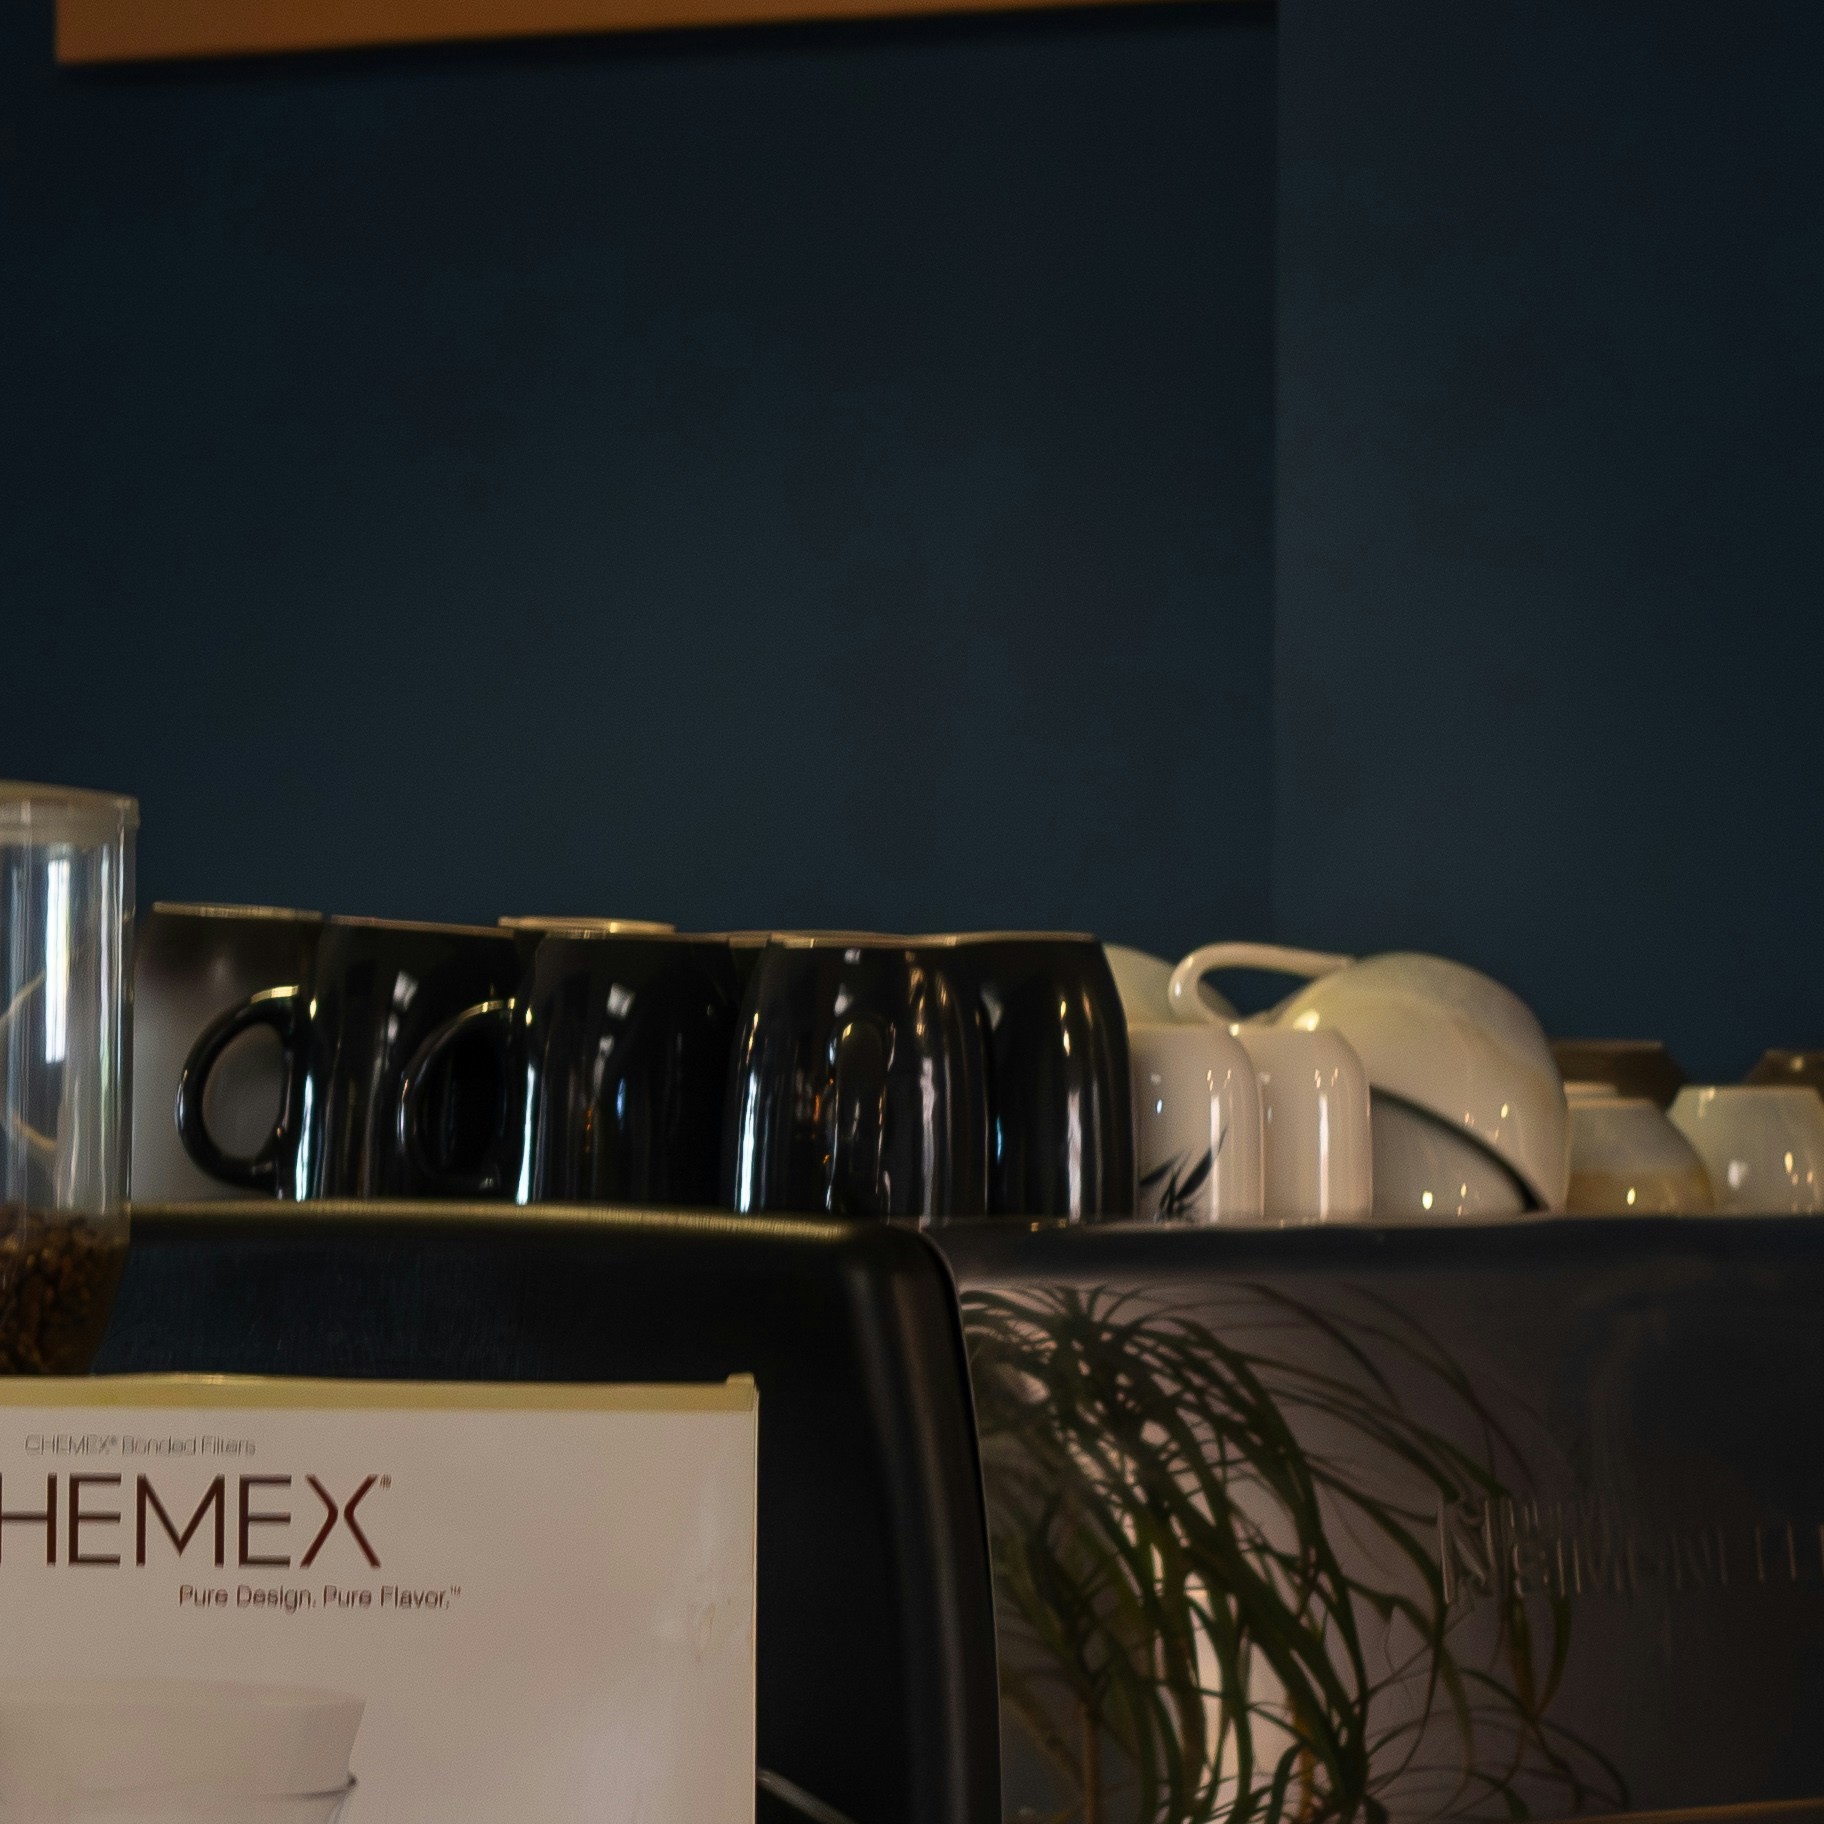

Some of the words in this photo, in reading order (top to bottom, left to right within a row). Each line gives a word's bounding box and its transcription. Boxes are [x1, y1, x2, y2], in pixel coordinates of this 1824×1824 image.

[121, 1433, 197, 1456] Bonded
[200, 1433, 256, 1456] Filters
[178, 1584, 228, 1609] Pure
[236, 1584, 316, 1614] Design.
[323, 1584, 372, 1609] Pure
